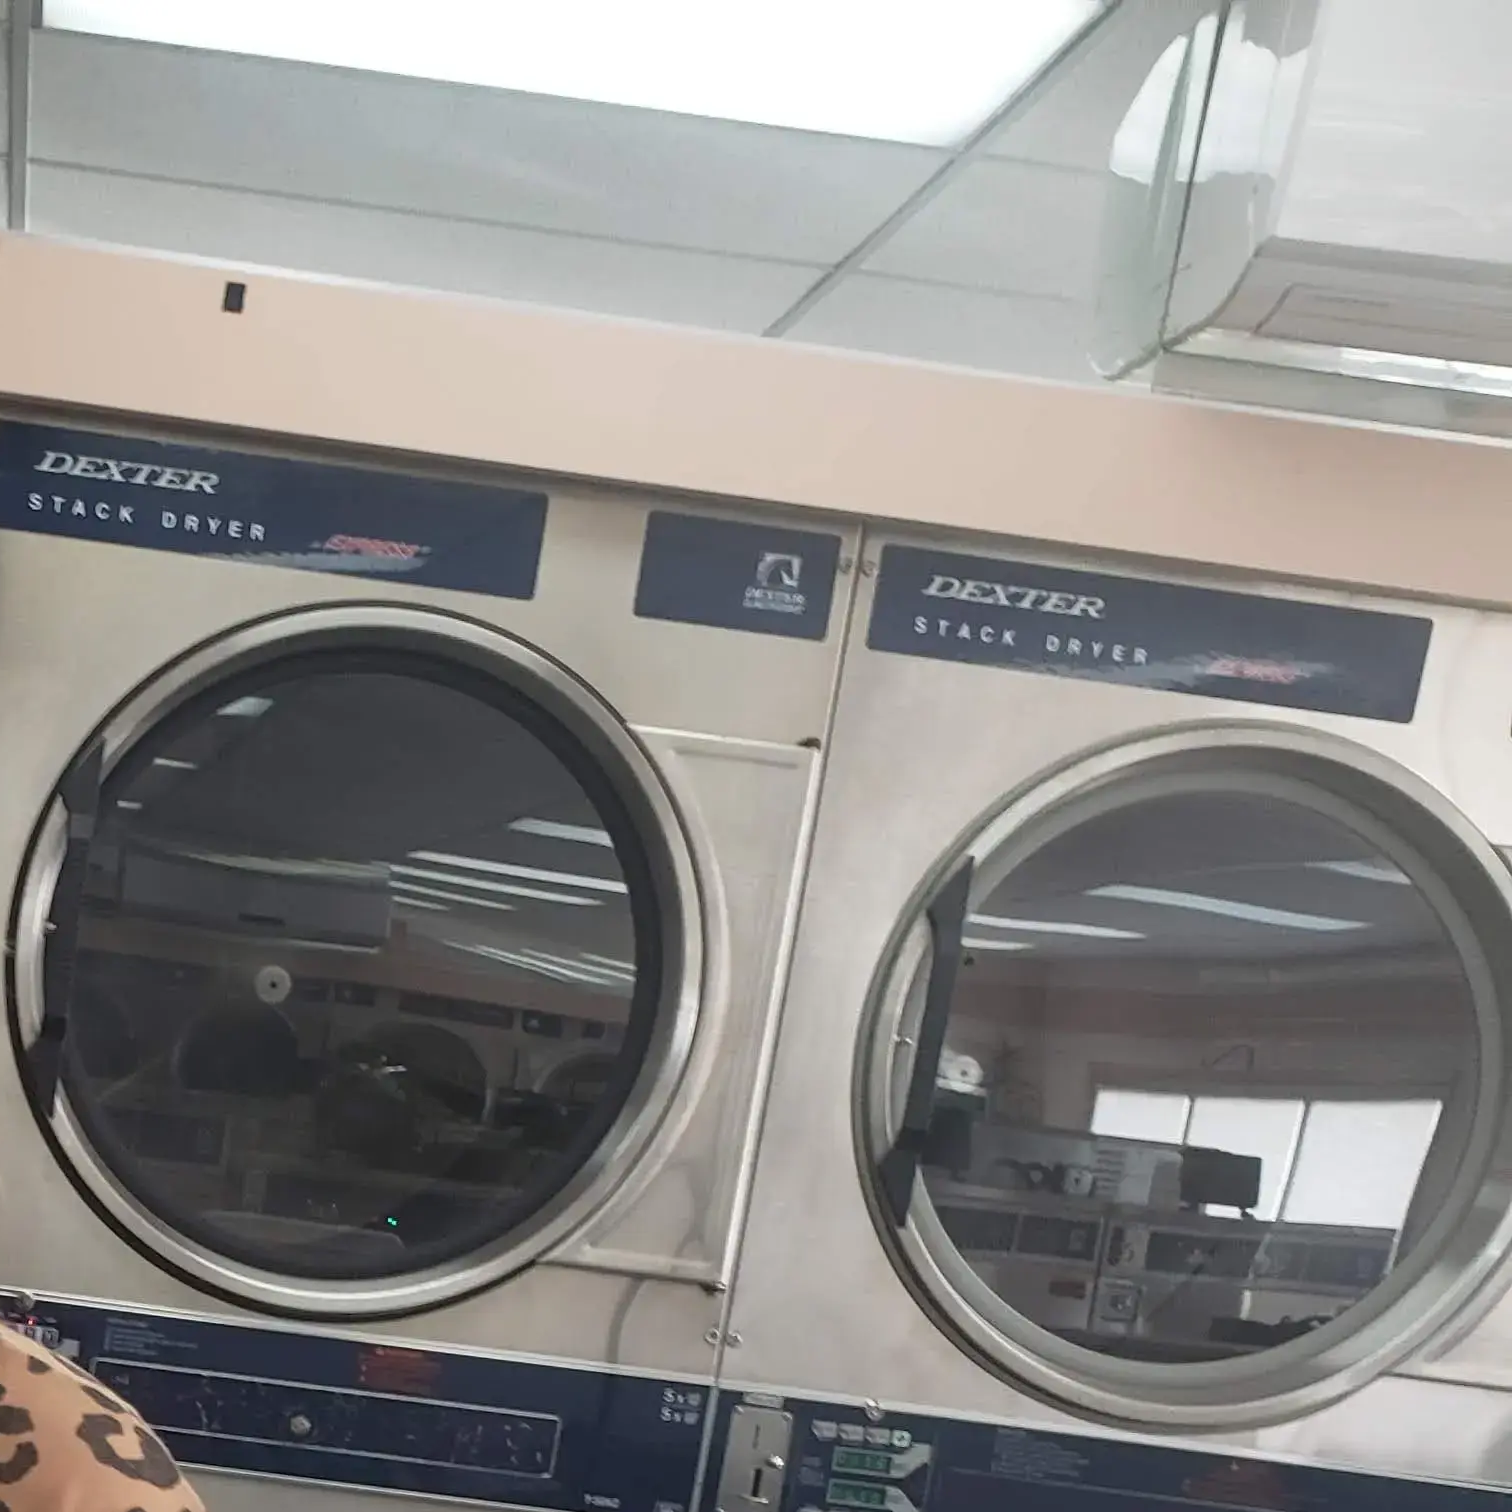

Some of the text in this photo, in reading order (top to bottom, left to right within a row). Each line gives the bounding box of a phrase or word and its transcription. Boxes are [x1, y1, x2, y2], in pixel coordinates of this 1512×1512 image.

[33, 450, 221, 495] DEXTER
[27, 492, 266, 542] STACK DRYER
[920, 574, 1107, 620] DEXTER
[913, 615, 1149, 666] STACK DRYER
